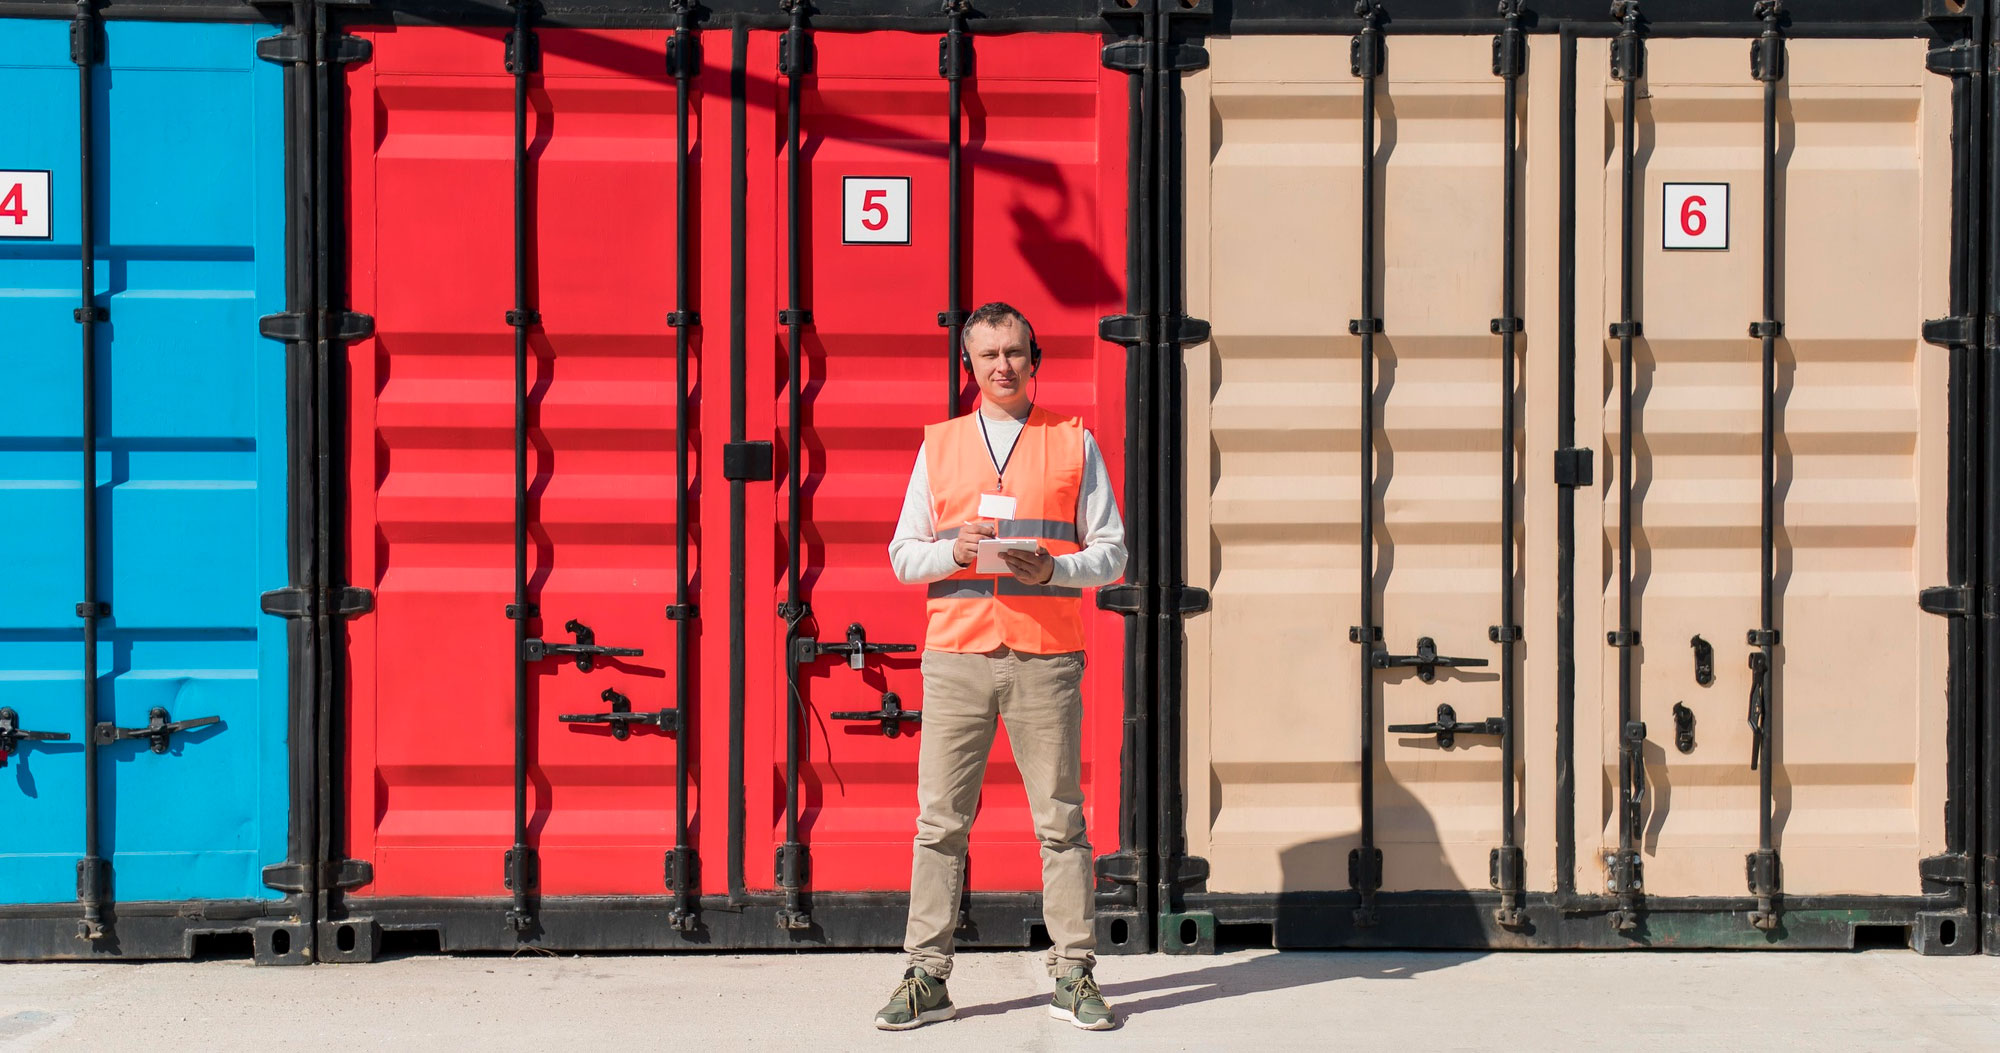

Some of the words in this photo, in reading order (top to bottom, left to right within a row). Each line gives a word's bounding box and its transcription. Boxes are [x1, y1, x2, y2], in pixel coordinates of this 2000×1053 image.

[0, 183, 28, 225] 4
[861, 190, 889, 232] 5
[1680, 195, 1707, 237] 6
